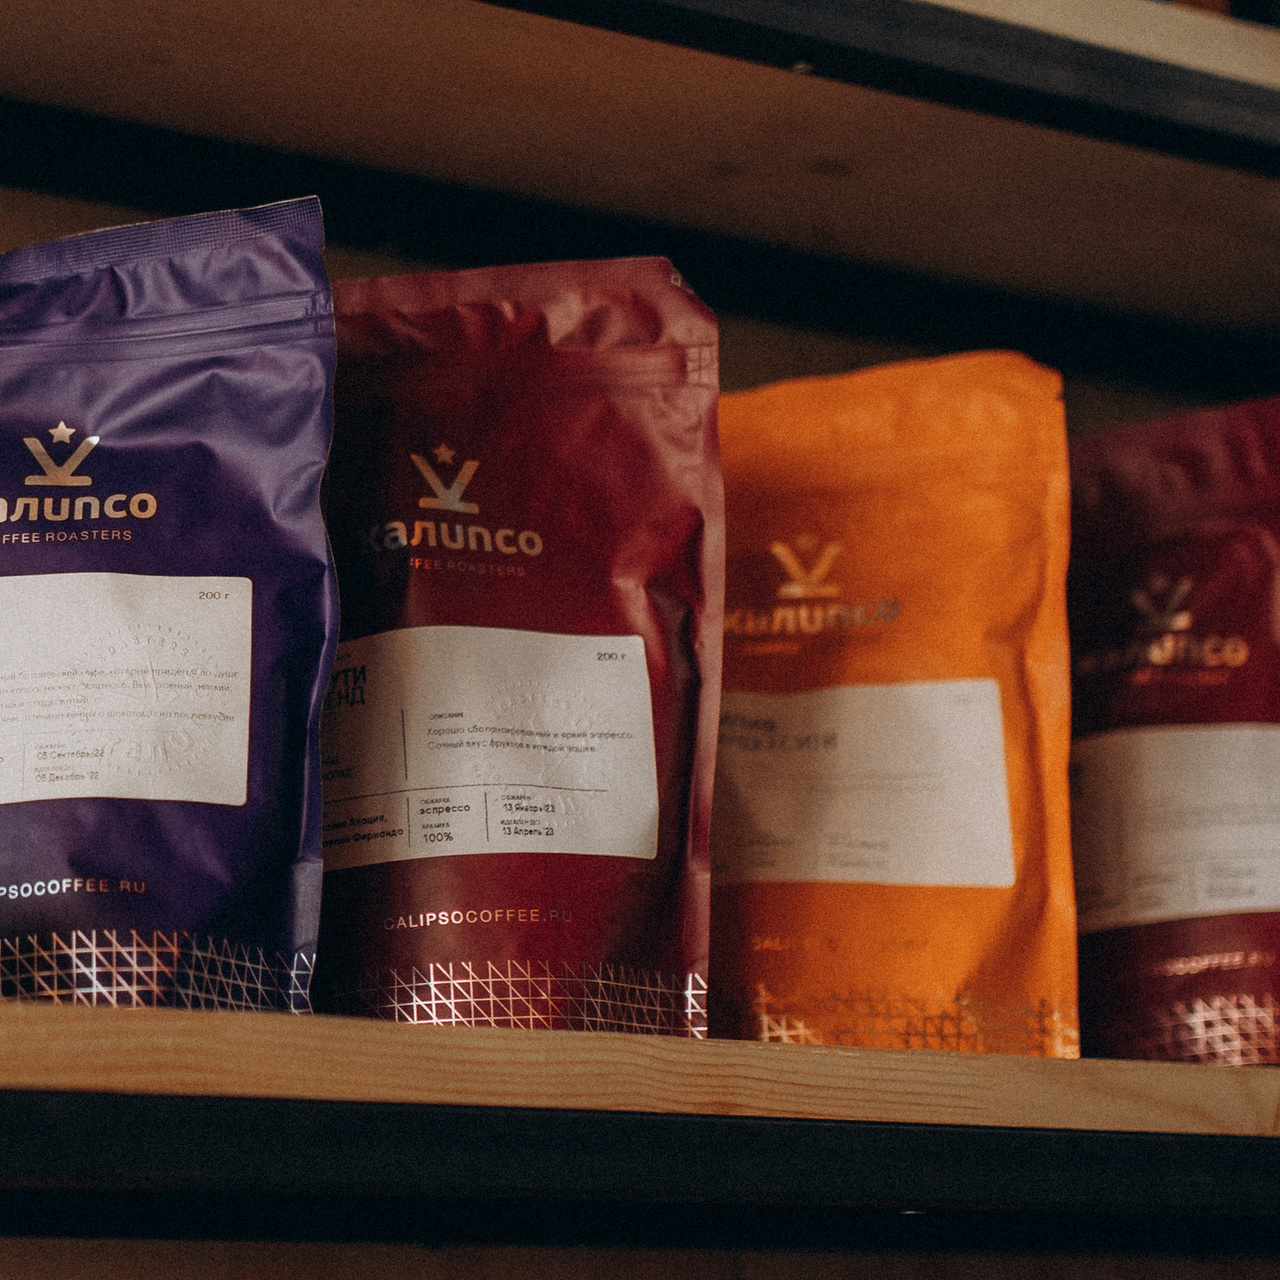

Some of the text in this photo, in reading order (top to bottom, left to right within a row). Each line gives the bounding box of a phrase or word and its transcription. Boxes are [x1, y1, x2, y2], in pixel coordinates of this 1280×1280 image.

[45, 530, 132, 542] ROASTERS
[199, 591, 221, 600] 200
[597, 652, 618, 661] 200
[331, 665, 367, 690] УТИ
[324, 685, 366, 710] ЕНД
[427, 727, 465, 736] Хорошо
[420, 804, 470, 815] эспрессо
[353, 829, 404, 842] Фернандо
[502, 826, 512, 836] 13
[513, 826, 542, 836] Апрель
[423, 832, 453, 843] 100%
